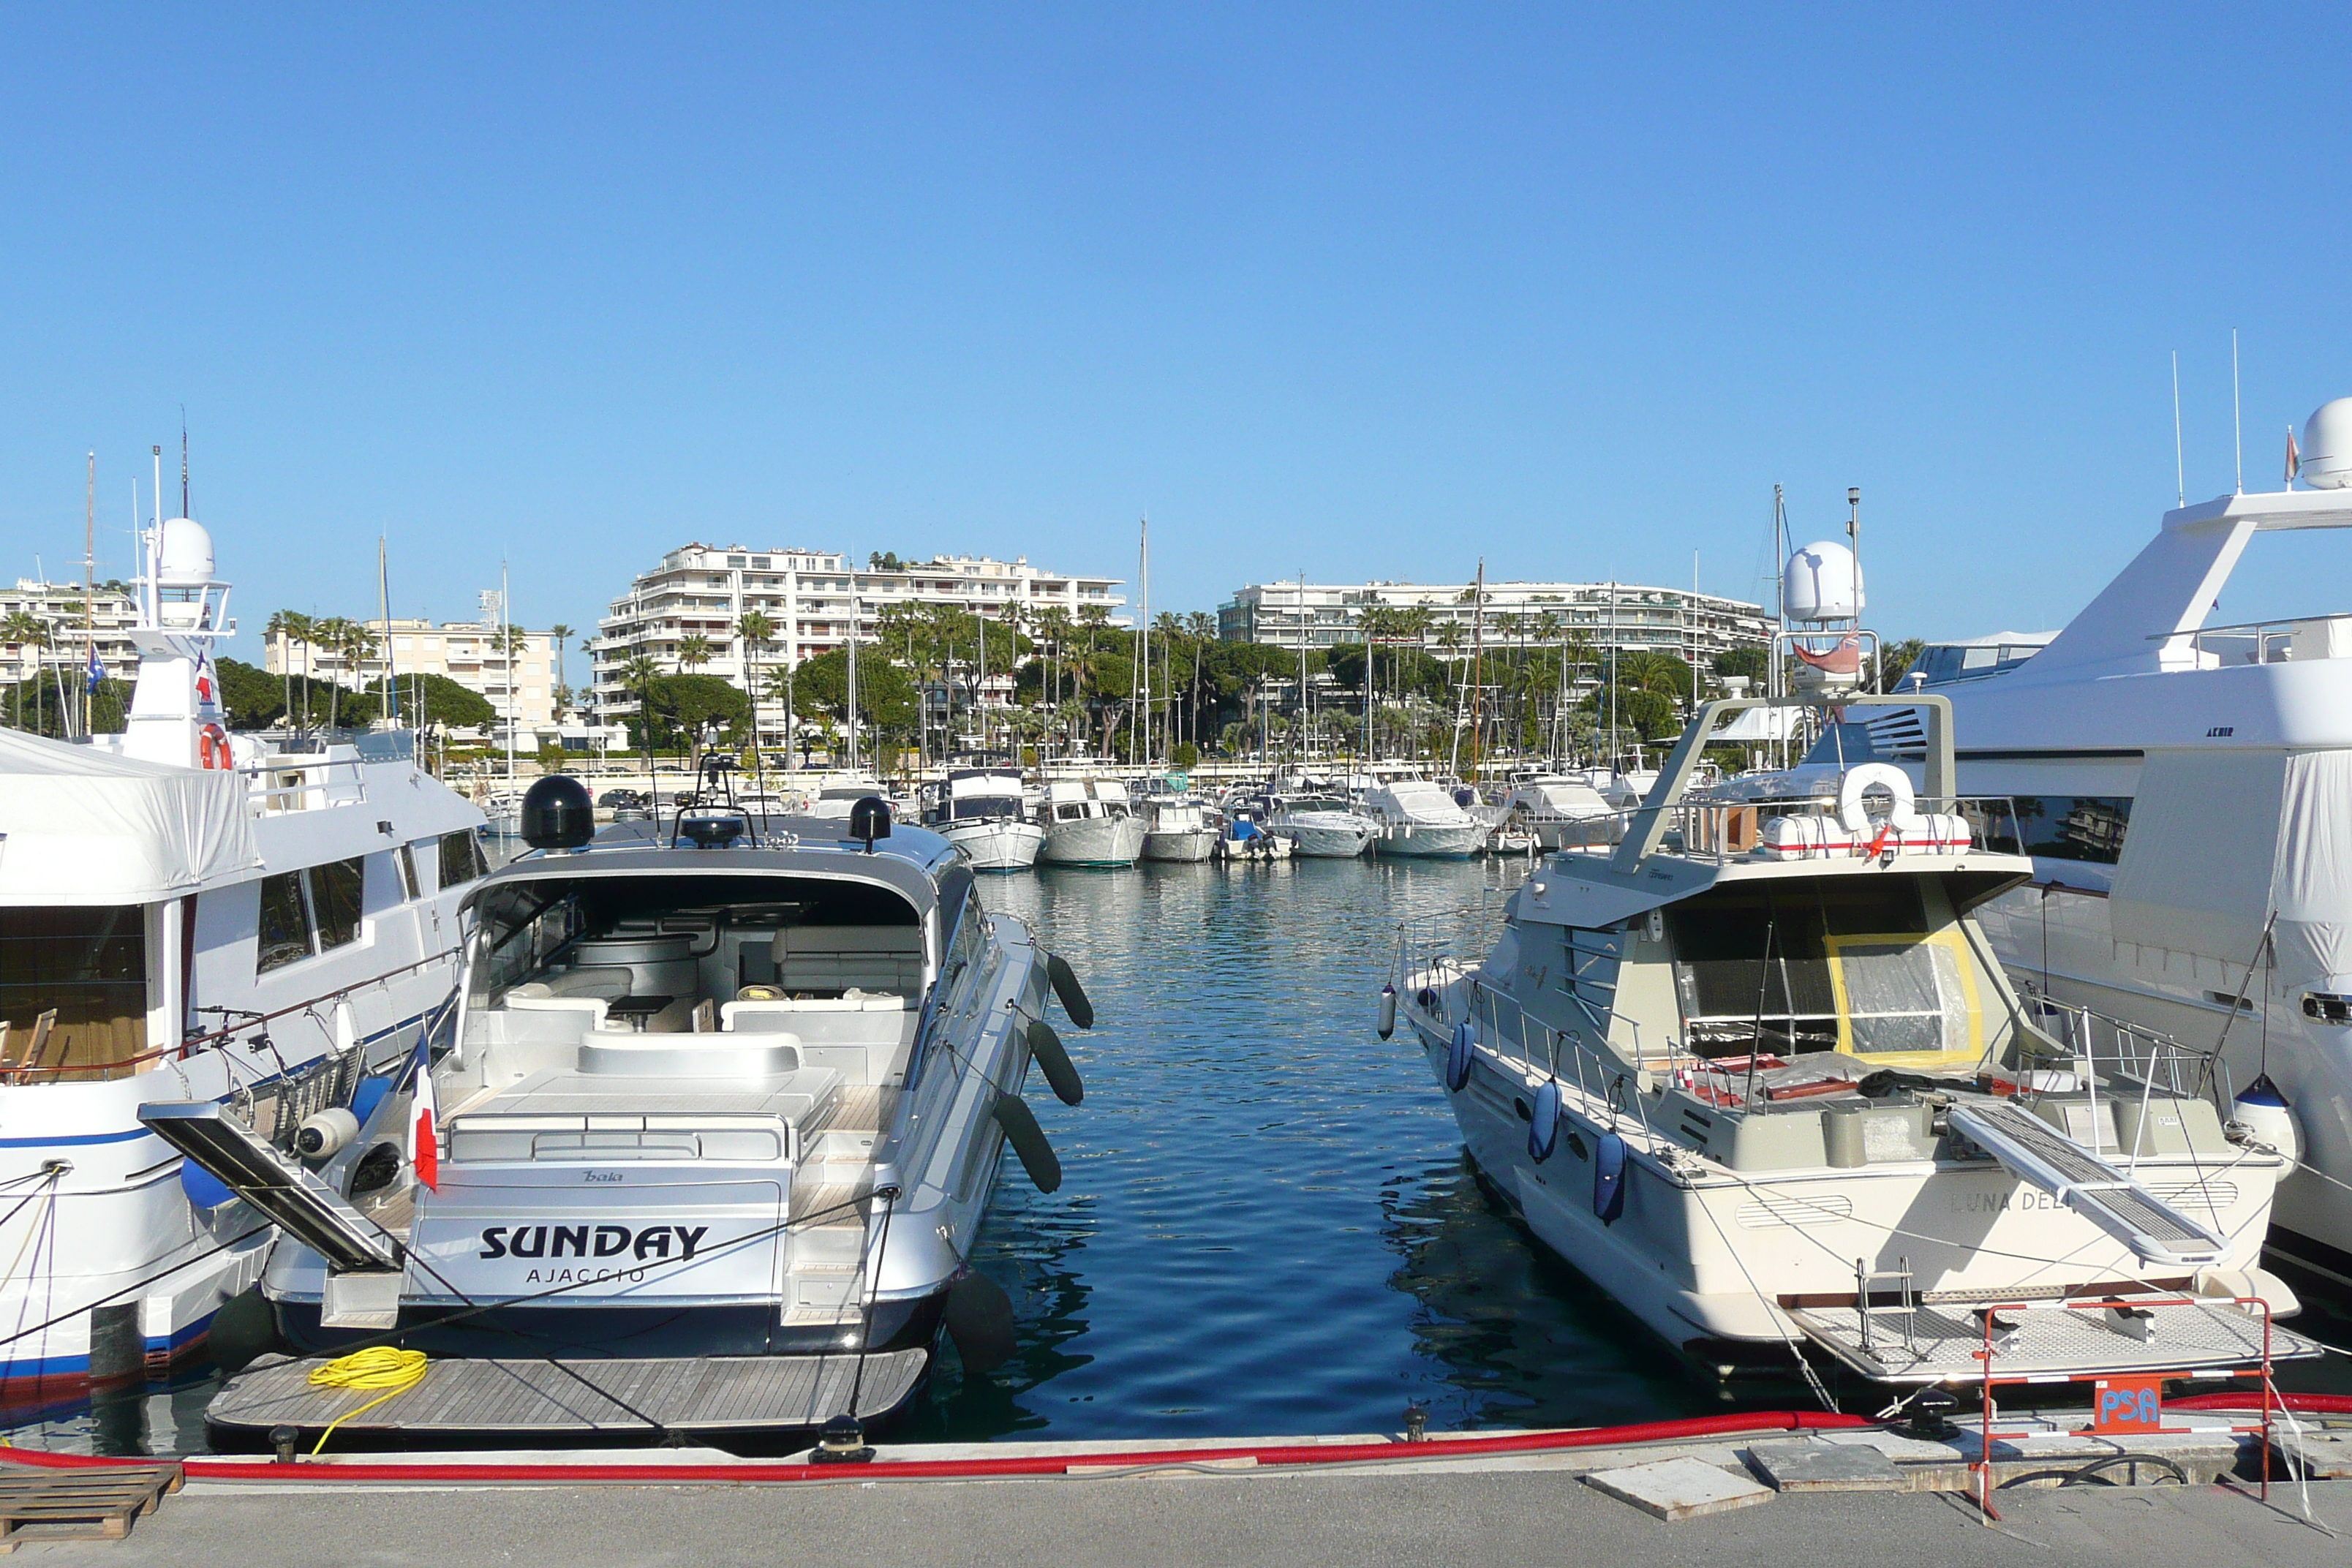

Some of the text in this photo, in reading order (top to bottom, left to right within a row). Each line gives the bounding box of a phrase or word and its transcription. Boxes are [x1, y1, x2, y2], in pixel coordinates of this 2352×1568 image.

[1950, 1193, 2010, 1212] LUNA
[479, 1226, 709, 1262] SUNDAY
[526, 1269, 644, 1283] AJACCIO
[2101, 1388, 2158, 1424] PSA
